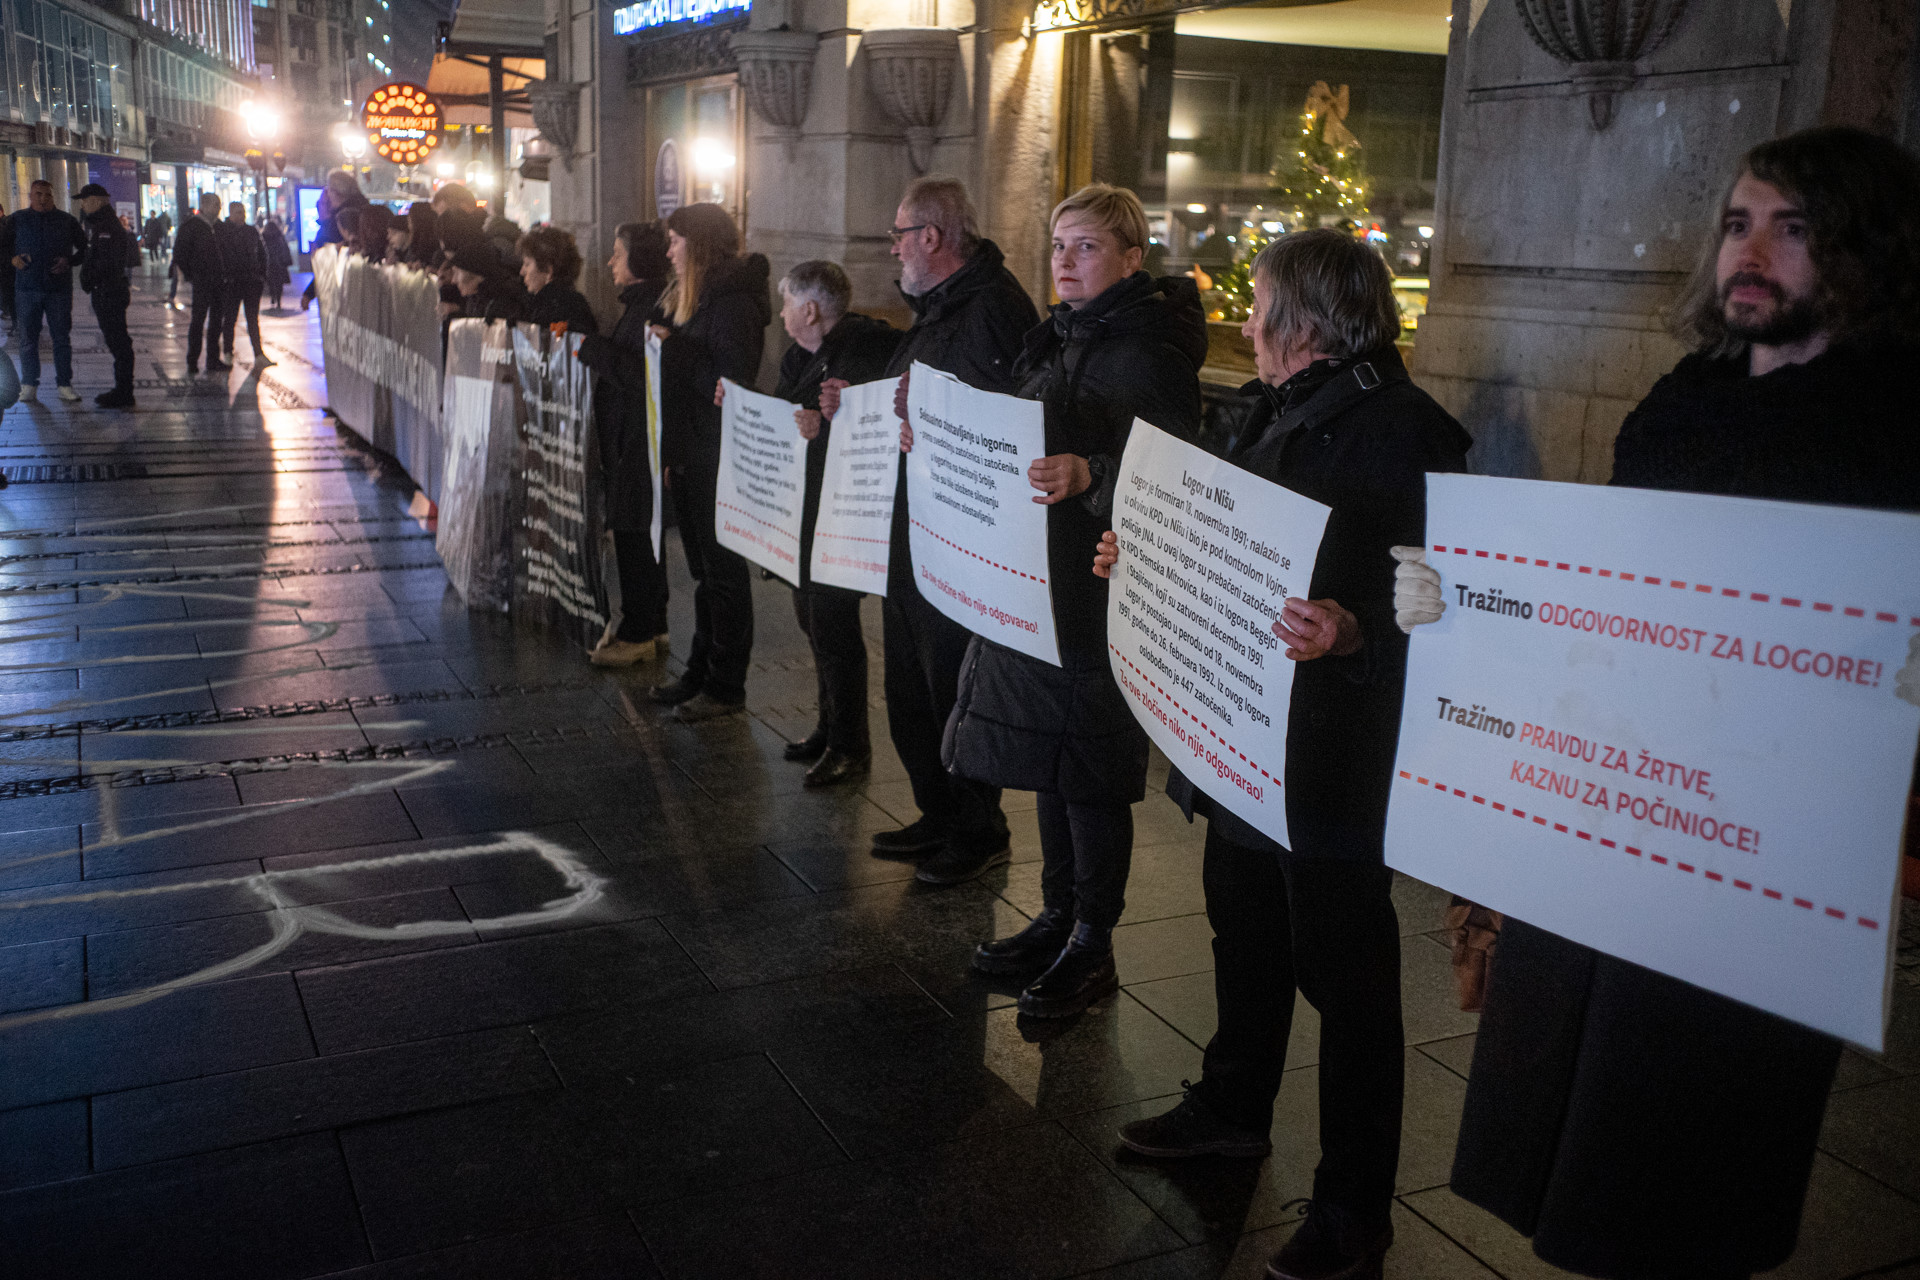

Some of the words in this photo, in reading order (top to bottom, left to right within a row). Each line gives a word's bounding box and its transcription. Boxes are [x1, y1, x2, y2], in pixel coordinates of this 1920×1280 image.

[979, 473, 997, 490] Srbije,
[981, 433, 1018, 455] logorima
[984, 457, 1019, 476] zatočenika
[1182, 470, 1205, 496] Logor
[1206, 487, 1213, 500] u
[1213, 487, 1235, 512] Nišu
[974, 490, 999, 509] silovanju
[1124, 494, 1129, 504] u
[1129, 496, 1149, 517] okviru
[1149, 506, 1163, 524] KPD
[1164, 517, 1169, 528] u
[1170, 518, 1185, 537] Nišu
[1189, 528, 1200, 546] bio
[1200, 535, 1208, 552] je
[1209, 543, 1224, 560] pod
[1224, 549, 1263, 584] kontrolom
[1266, 573, 1287, 598] Vojne
[1130, 471, 1148, 491] Logor
[1147, 480, 1154, 496] je
[1155, 484, 1185, 510] formiran
[1185, 500, 1193, 516] 18.
[1194, 509, 1229, 537] novembra
[1231, 526, 1249, 550] 1991;
[1249, 540, 1280, 564] nalazio
[1280, 556, 1291, 571] se
[921, 565, 928, 579] Za
[958, 590, 973, 607] niko
[973, 598, 987, 616] nije
[988, 607, 1039, 635] odgovarao!
[1121, 517, 1141, 538] policije
[1141, 527, 1155, 546] JNA.
[1157, 536, 1163, 549] U
[1164, 543, 1179, 562] ovaj
[1179, 547, 1197, 570] logor
[1197, 563, 1207, 577] su
[1207, 569, 1242, 599] prebačeni
[1121, 536, 1126, 550] iz
[1127, 541, 1138, 557] KPD
[1140, 549, 1164, 576] Sremska
[1166, 566, 1198, 600] Mitrovica,
[1200, 587, 1213, 607] kao
[1218, 599, 1224, 615] iz
[1225, 604, 1248, 631] logora
[1250, 621, 1278, 650] Begejci
[1118, 601, 1131, 621] 1991.
[1131, 614, 1149, 637] godine
[1150, 628, 1158, 643] do
[1159, 634, 1168, 652] 26.
[1169, 642, 1197, 673] februara
[1199, 663, 1216, 688] 1992.
[1217, 677, 1224, 694] Iz
[1225, 687, 1243, 712] ovog
[1245, 697, 1270, 728] logora
[1126, 584, 1141, 605] Logor
[1141, 595, 1146, 611] je
[1146, 603, 1172, 630] postojao
[1173, 624, 1177, 634] u
[1179, 628, 1203, 652] perodu
[1204, 646, 1214, 660] od
[1215, 650, 1223, 668] 18.
[1225, 661, 1263, 696] novembra
[1130, 565, 1154, 596] Stajićevo,
[1155, 584, 1168, 604] koji
[1168, 596, 1176, 608] su
[1177, 602, 1209, 631] zatvoreni
[1210, 622, 1246, 656] decembra
[1248, 646, 1264, 670] 1991.
[1455, 583, 1534, 620] Tražimo
[1538, 602, 1707, 654] ODGOVORNOST
[1710, 633, 1744, 662] ZA
[1752, 641, 1883, 688] LOGORE!
[1139, 644, 1173, 679] oslobođeno
[1172, 669, 1180, 685] je
[1181, 677, 1194, 694] 447
[1195, 688, 1234, 727] zatočenika.
[1120, 668, 1129, 688] Za
[1129, 681, 1141, 697] ove
[1142, 692, 1168, 726] zločine
[1168, 717, 1186, 742] niko
[1187, 734, 1204, 758] nije
[1205, 750, 1264, 804] odgovarao!
[1437, 696, 1516, 739] Tražimo
[1519, 722, 1597, 763] PRAVDU
[1600, 745, 1630, 774] ZA
[1634, 748, 1716, 802] ŽRTVE,
[1509, 759, 1579, 800] KAZNU
[1582, 782, 1610, 811] ZA
[1616, 796, 1761, 855] POČINIOCE!
